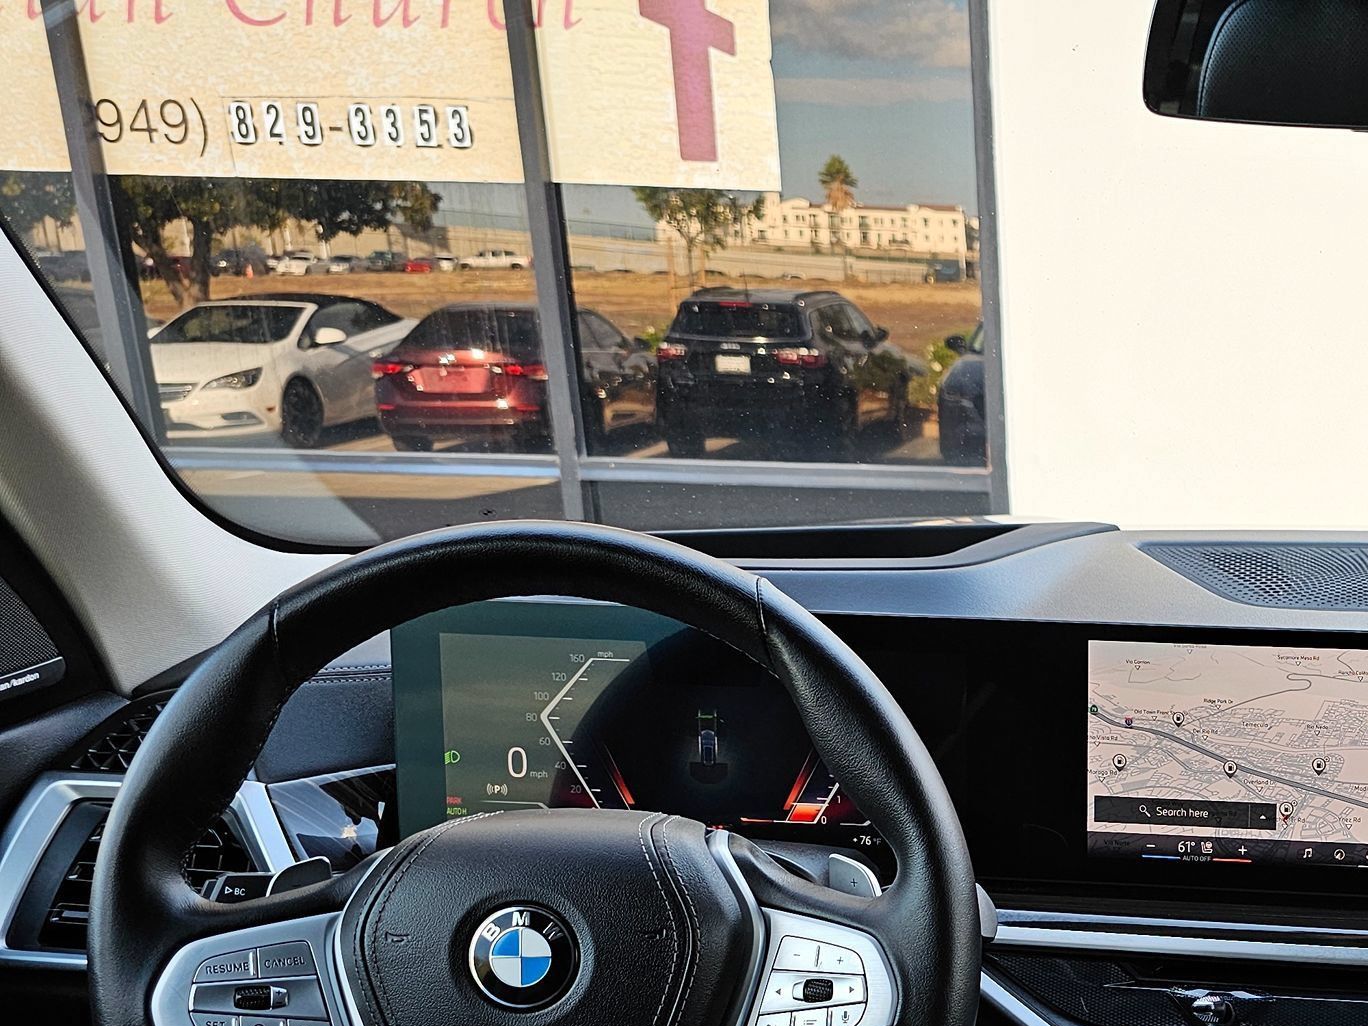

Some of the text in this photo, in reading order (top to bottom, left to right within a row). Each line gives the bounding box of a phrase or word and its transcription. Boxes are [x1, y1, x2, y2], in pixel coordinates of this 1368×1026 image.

[230, 101, 473, 149] 829-3353
[569, 653, 585, 663] 160
[551, 672, 566, 681] 120
[534, 691, 549, 700] 100
[526, 712, 537, 721] 80
[539, 737, 551, 745] 60
[507, 746, 527, 778] 0
[554, 761, 567, 770] 40
[530, 769, 548, 779] mph
[570, 785, 582, 794] 20
[446, 807, 460, 815] AUTO
[1157, 806, 1186, 817] Search
[1189, 808, 1209, 818] here
[821, 815, 827, 825] 0
[234, 888, 246, 896] BC
[481, 911, 563, 942] BMW
[264, 956, 306, 969] CANCEL
[205, 961, 250, 975] RESUME
